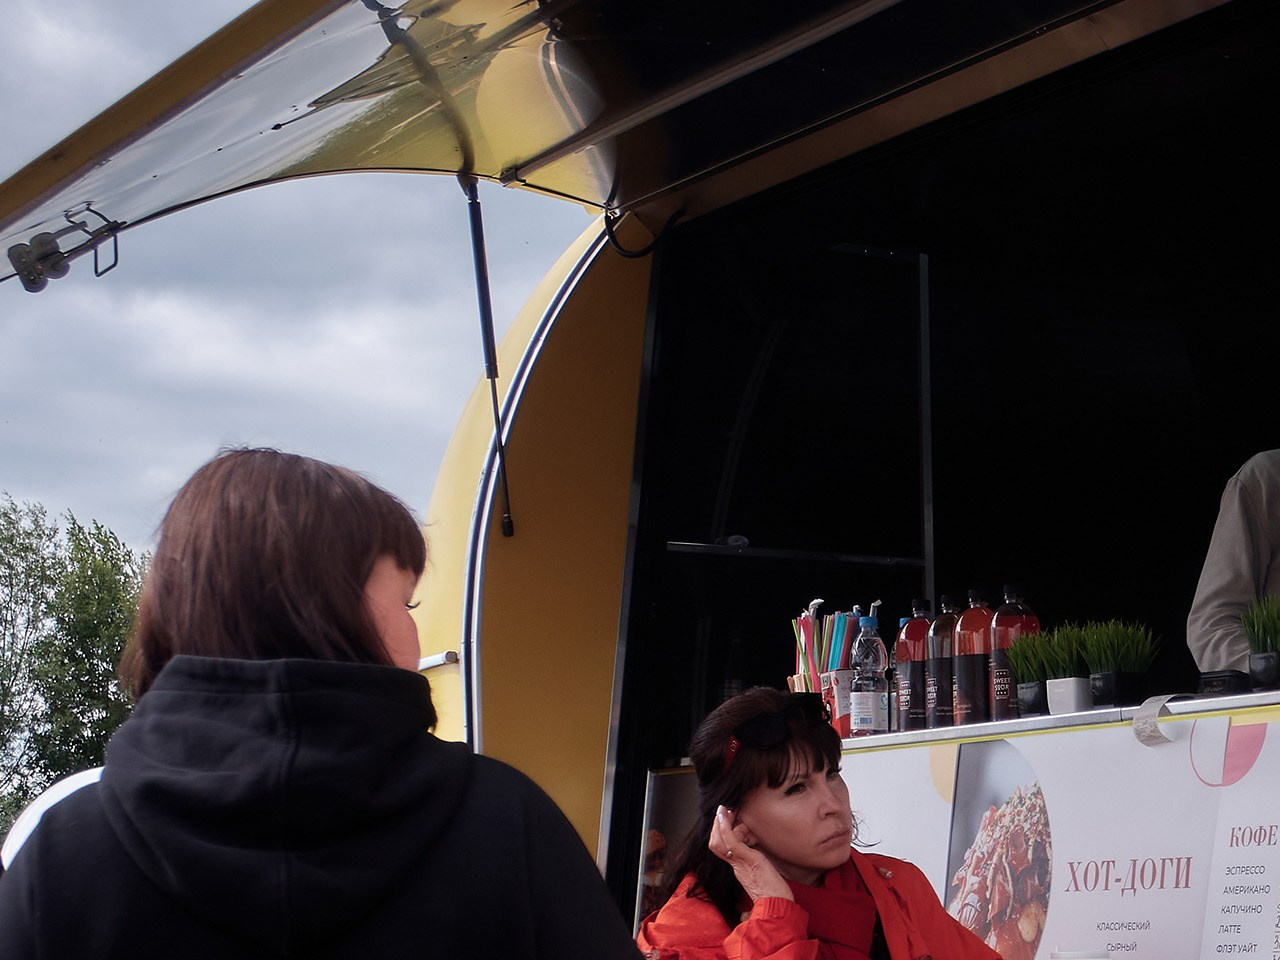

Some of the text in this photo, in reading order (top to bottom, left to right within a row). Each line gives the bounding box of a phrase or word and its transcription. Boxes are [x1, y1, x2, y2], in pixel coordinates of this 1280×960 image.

[1229, 825, 1278, 848] КОФЕ
[1225, 865, 1266, 875] ЭСПРЕССО
[1065, 856, 1193, 898] ХОТ-ДОГИ
[1223, 885, 1271, 895] АМЕРИКАНО
[1221, 904, 1263, 914] КАПУЧИНО
[1097, 921, 1151, 931] КЛАССИЧЕСКИЙ
[1218, 924, 1241, 934] ЛАТТЕ
[1106, 942, 1138, 952] СЫРНЫЙ
[1216, 943, 1258, 953] ФЛЭТ УАЙТ
